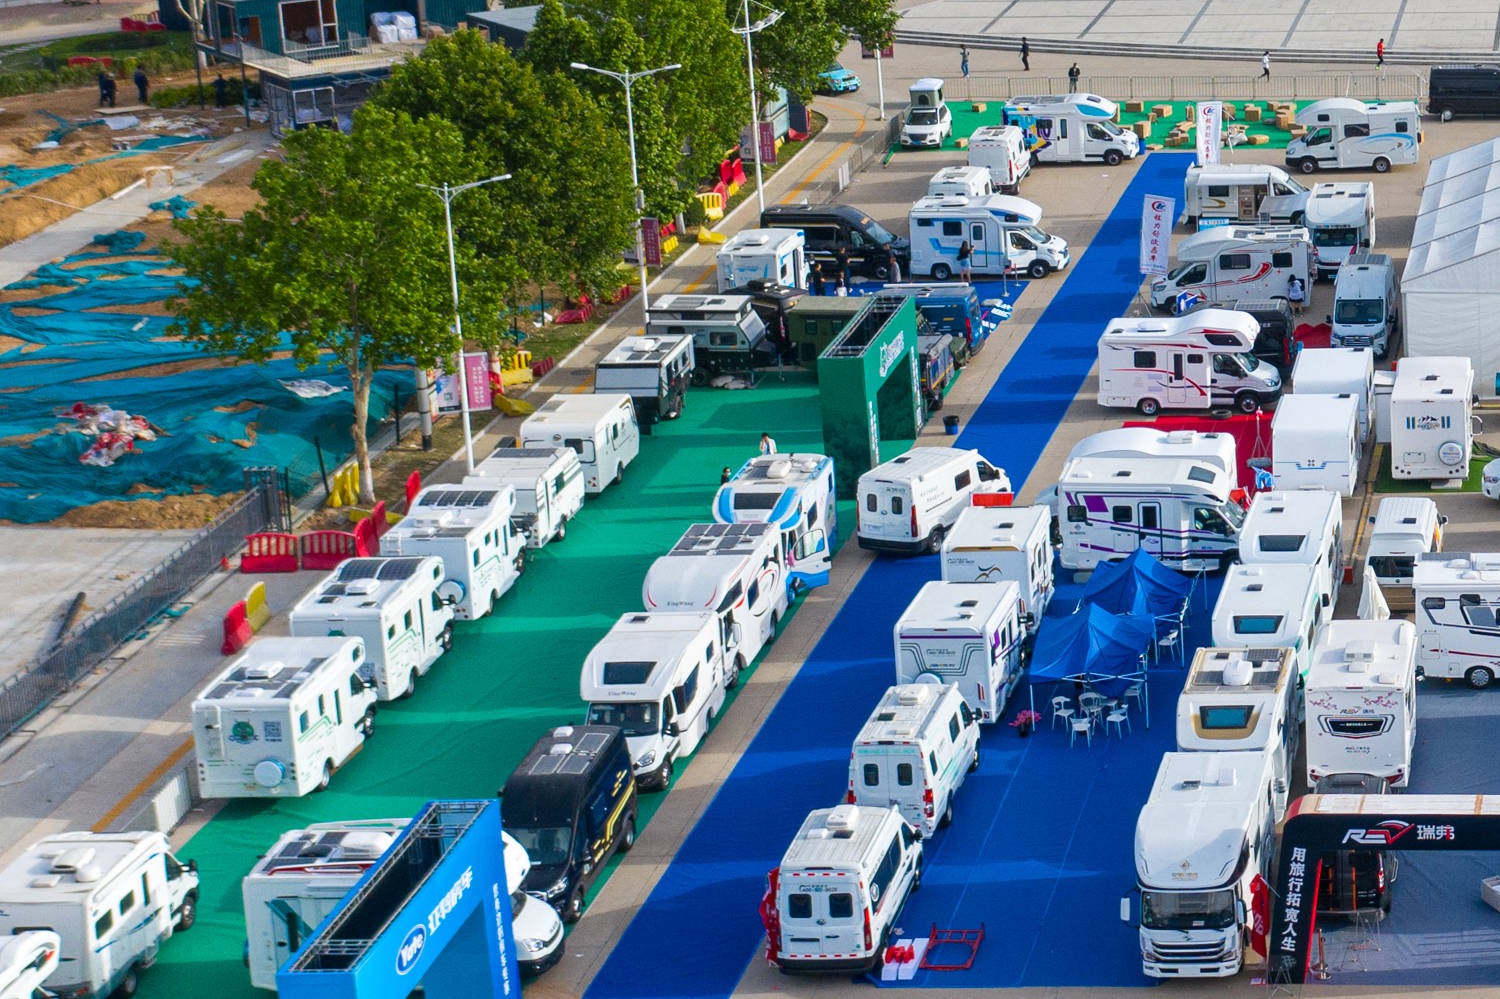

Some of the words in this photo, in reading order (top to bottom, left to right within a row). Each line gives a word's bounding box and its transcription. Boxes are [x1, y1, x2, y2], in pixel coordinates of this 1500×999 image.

[1342, 820, 1415, 845] REV
[1417, 824, 1456, 841] 瑞弗
[1280, 847, 1307, 952] 用旅行拓宽人生
